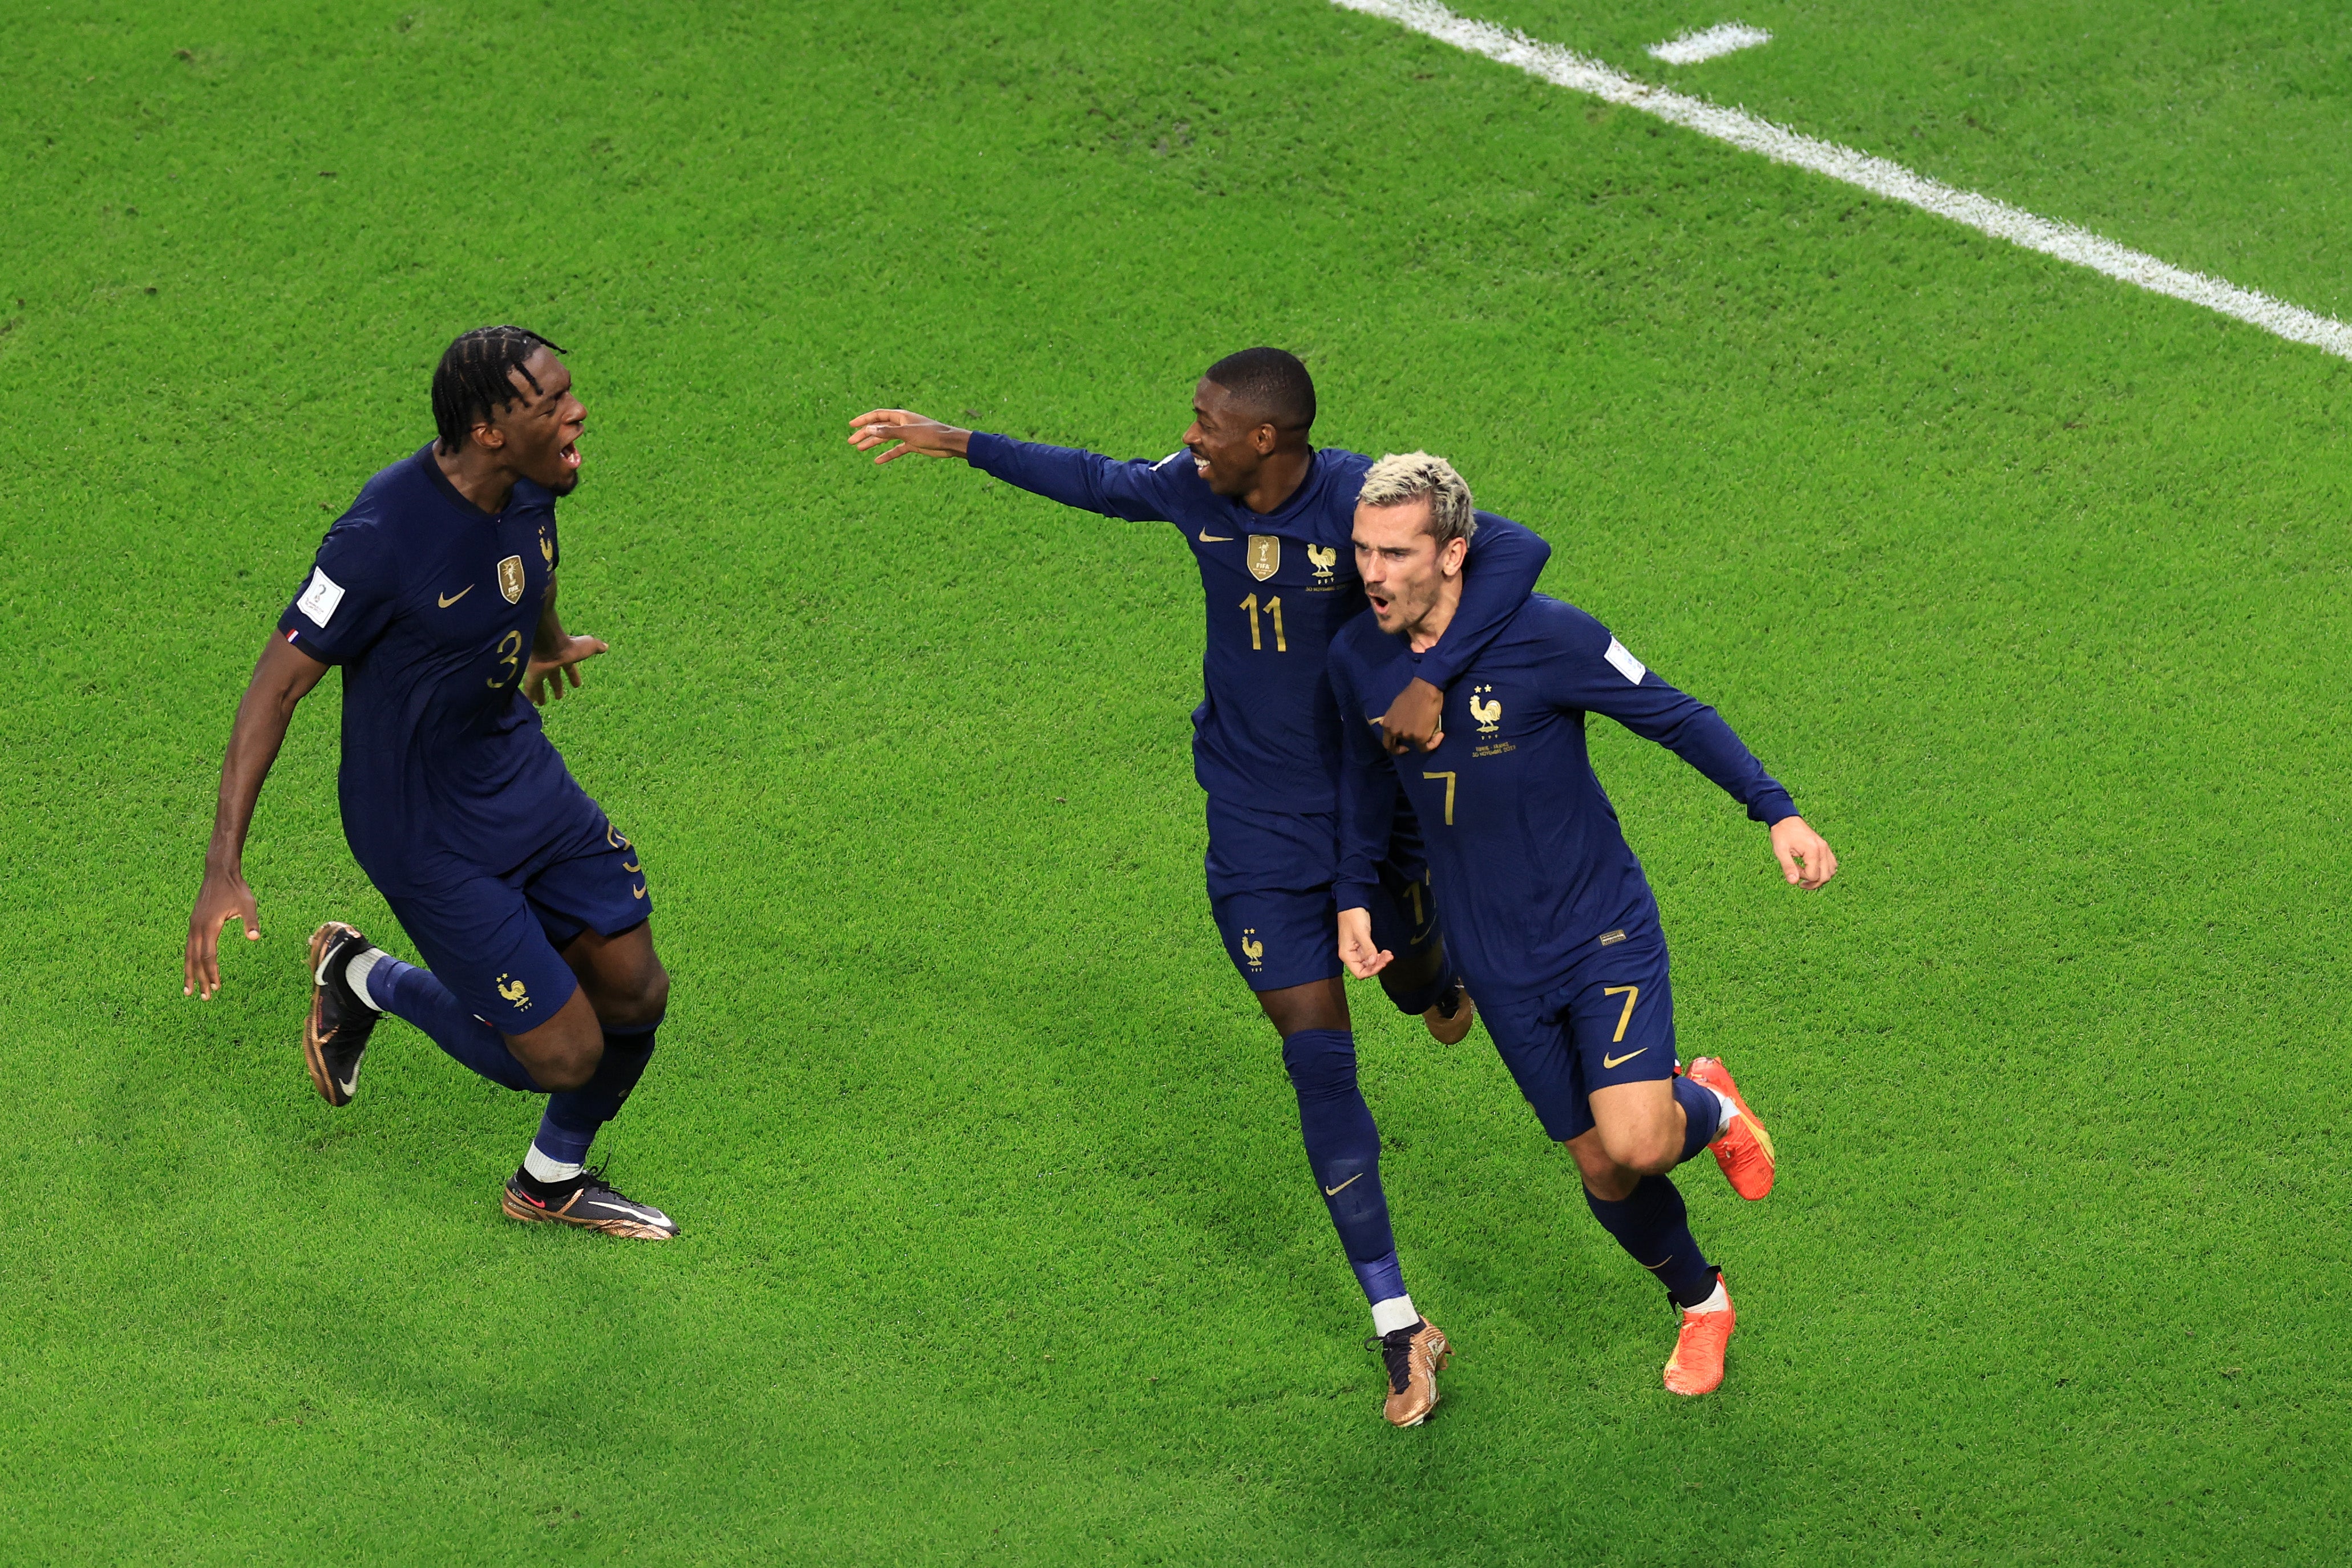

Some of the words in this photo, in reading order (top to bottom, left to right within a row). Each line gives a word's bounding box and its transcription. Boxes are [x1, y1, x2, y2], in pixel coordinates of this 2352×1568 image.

[1238, 592, 1286, 651] 11
[487, 630, 522, 688] 3
[1423, 771, 1455, 825] 7
[1604, 986, 1639, 1042] 7
